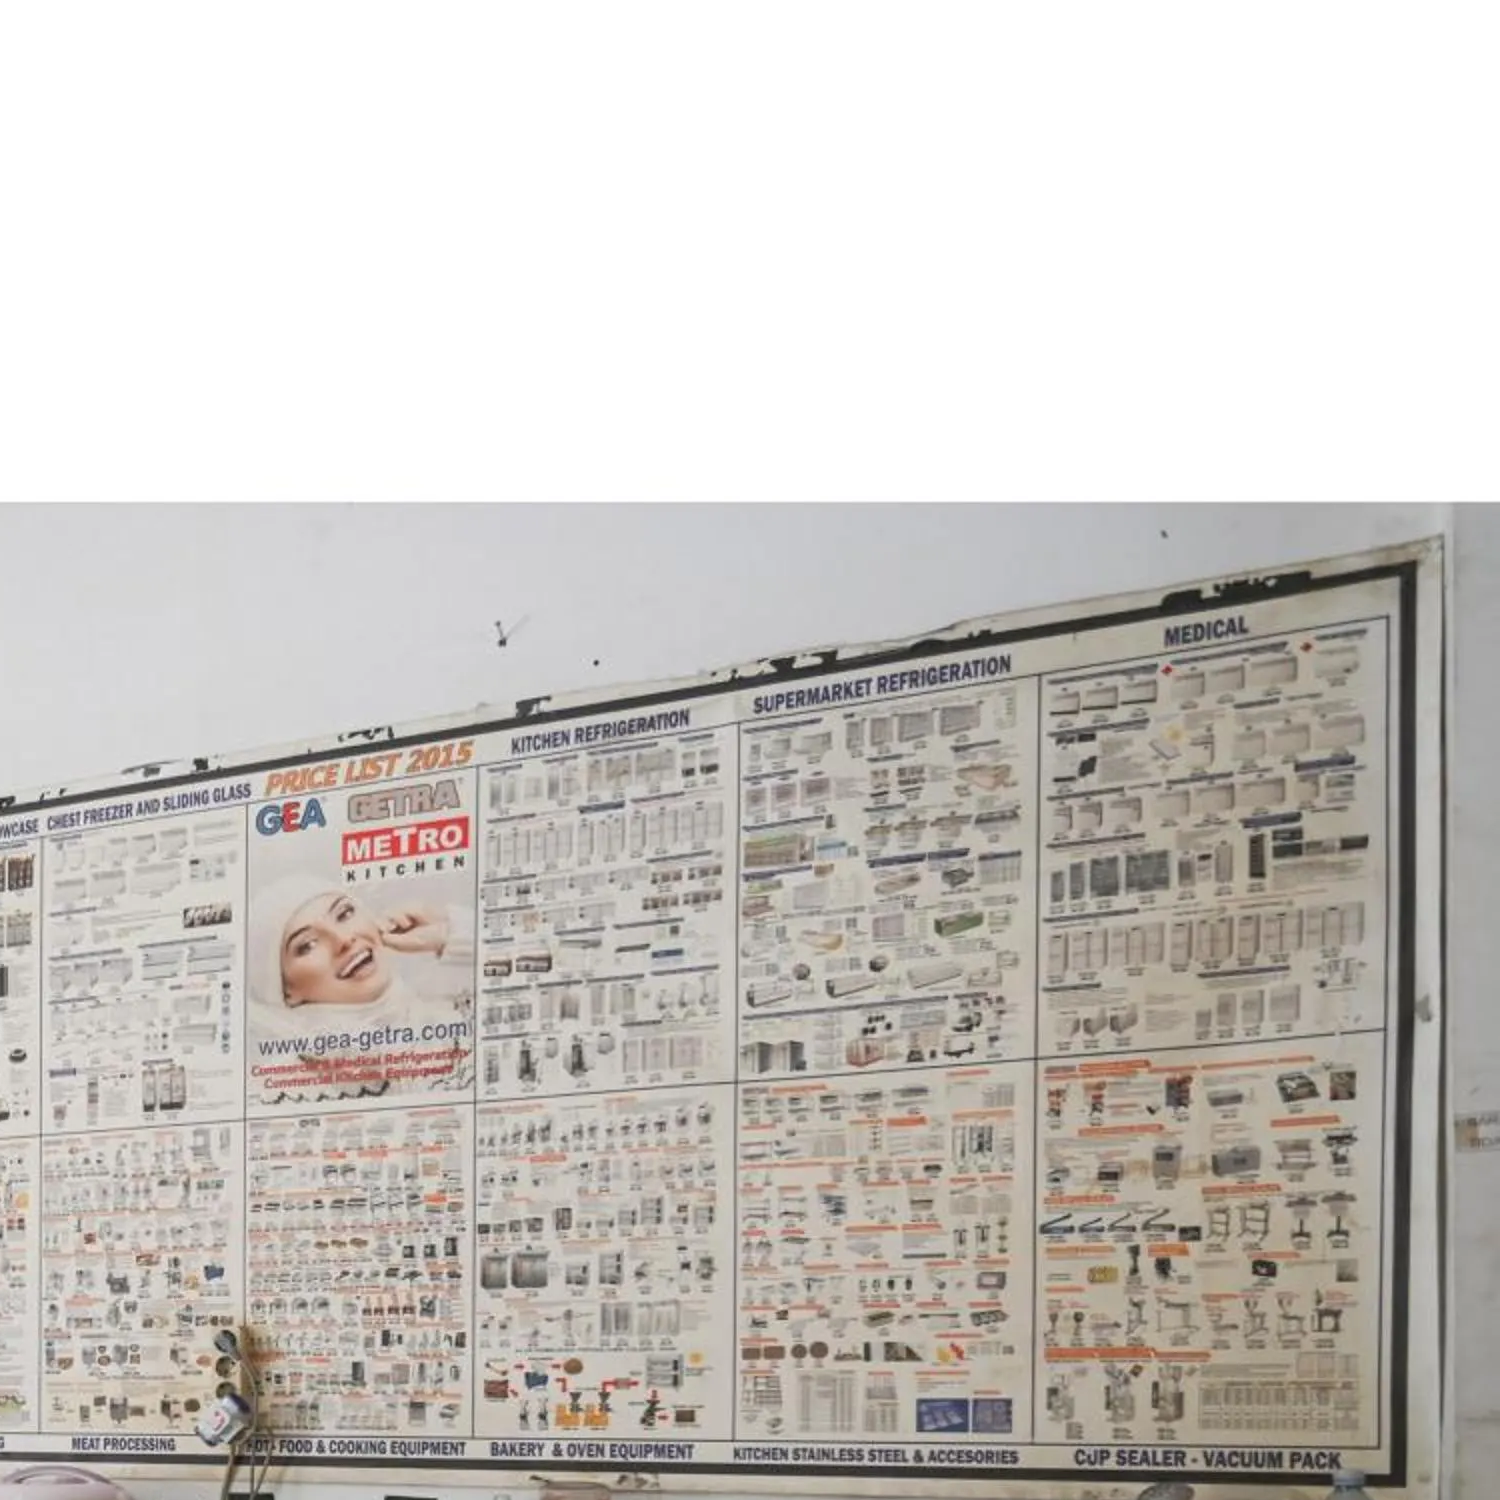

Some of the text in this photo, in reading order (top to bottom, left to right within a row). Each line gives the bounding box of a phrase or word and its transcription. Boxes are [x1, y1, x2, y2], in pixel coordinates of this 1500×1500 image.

[1164, 616, 1249, 646] MEDICAL
[753, 654, 1011, 714] SUPERMARKET REFRIGERATION
[511, 709, 690, 754] KITCHEN REFRIGERATION
[264, 739, 475, 797] PRICE LIST 2015
[47, 783, 252, 831] CHEST FREEZER AND SLIDING GLASS
[255, 797, 327, 836] GEA
[346, 825, 464, 862] METRO
[347, 855, 465, 882] KITCHEN
[258, 1021, 467, 1056] www.gea-getra.com
[72, 1438, 176, 1451] MEAT PROCESSING
[279, 1439, 313, 1453] FOOD
[316, 1440, 326, 1453] &
[328, 1440, 386, 1455] COOKING
[390, 1441, 467, 1457] EQUIPMENT
[490, 1441, 694, 1461] BAKERY & OVEN EQUIPMENT
[733, 1447, 1020, 1465] KITCHEN STAINLESS STEEL & ACCESORIES
[1115, 1449, 1186, 1467] SEALER
[1203, 1450, 1283, 1468] VACUUM
[1289, 1451, 1342, 1470] PACK
